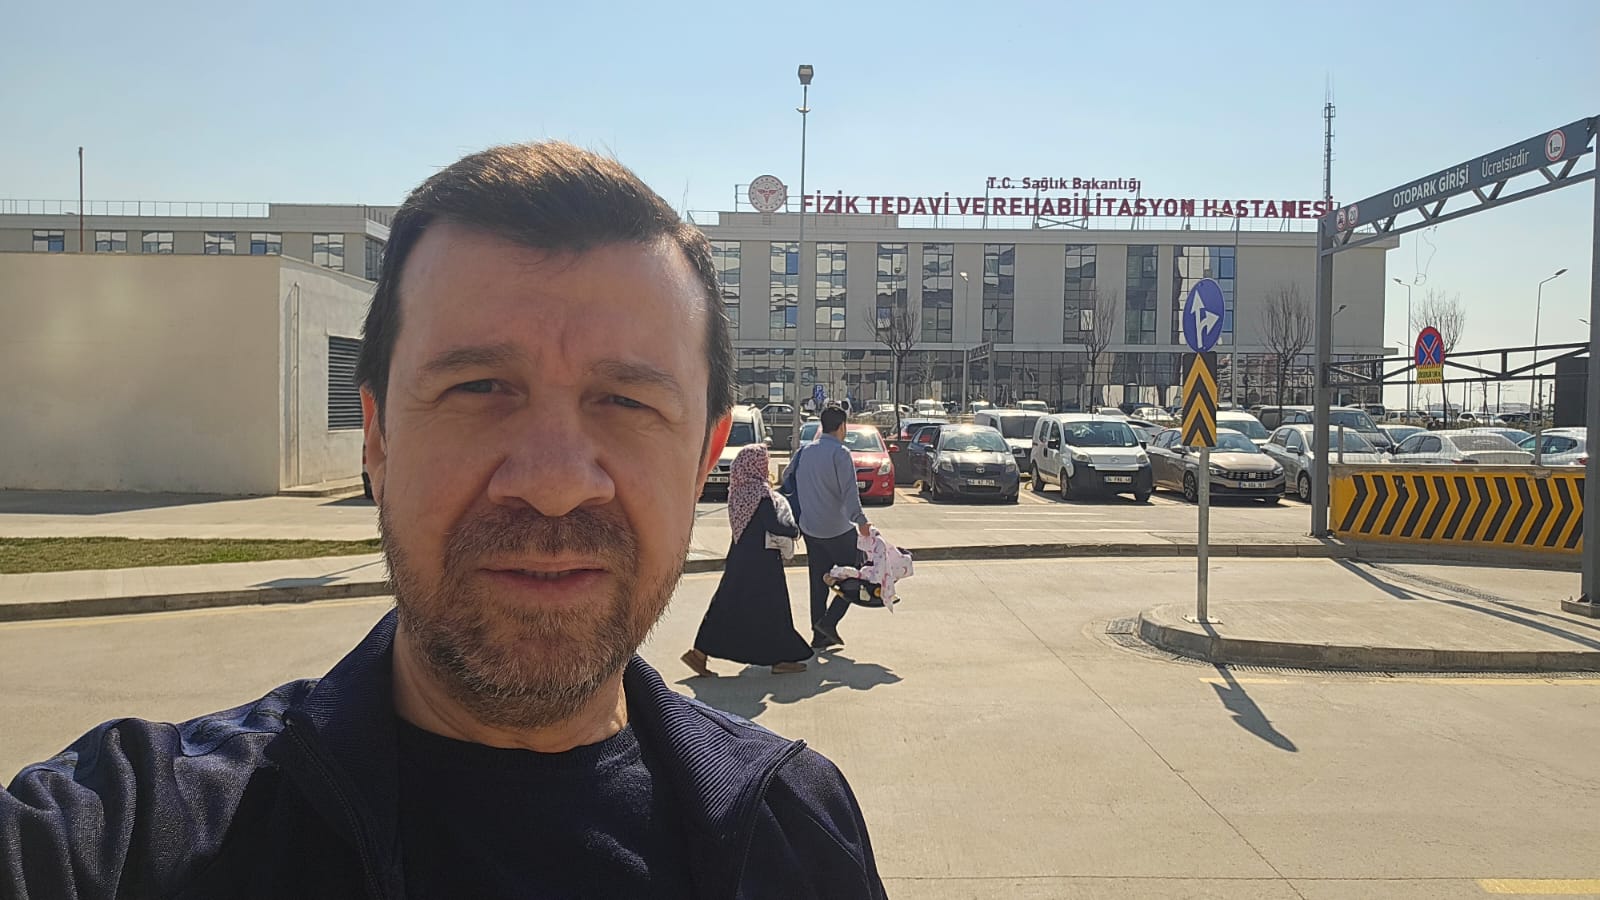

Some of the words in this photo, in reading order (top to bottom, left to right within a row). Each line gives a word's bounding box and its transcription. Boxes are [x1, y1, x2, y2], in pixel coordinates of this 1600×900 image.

[987, 176, 1015, 189] T.C.
[1022, 177, 1067, 191] Sağlık
[1072, 177, 1141, 193] Bakanlığı
[1393, 182, 1437, 209] OTOPARK
[1438, 164, 1469, 193] GİRİŞİ
[1481, 149, 1530, 178] Ücretsizdir
[802, 190, 860, 214] FİZİK
[866, 192, 950, 215] TEDAVİ
[955, 197, 986, 216] VE
[992, 193, 1195, 217] REHABİLİTASYON
[1203, 196, 1333, 218] HASTANESİ
